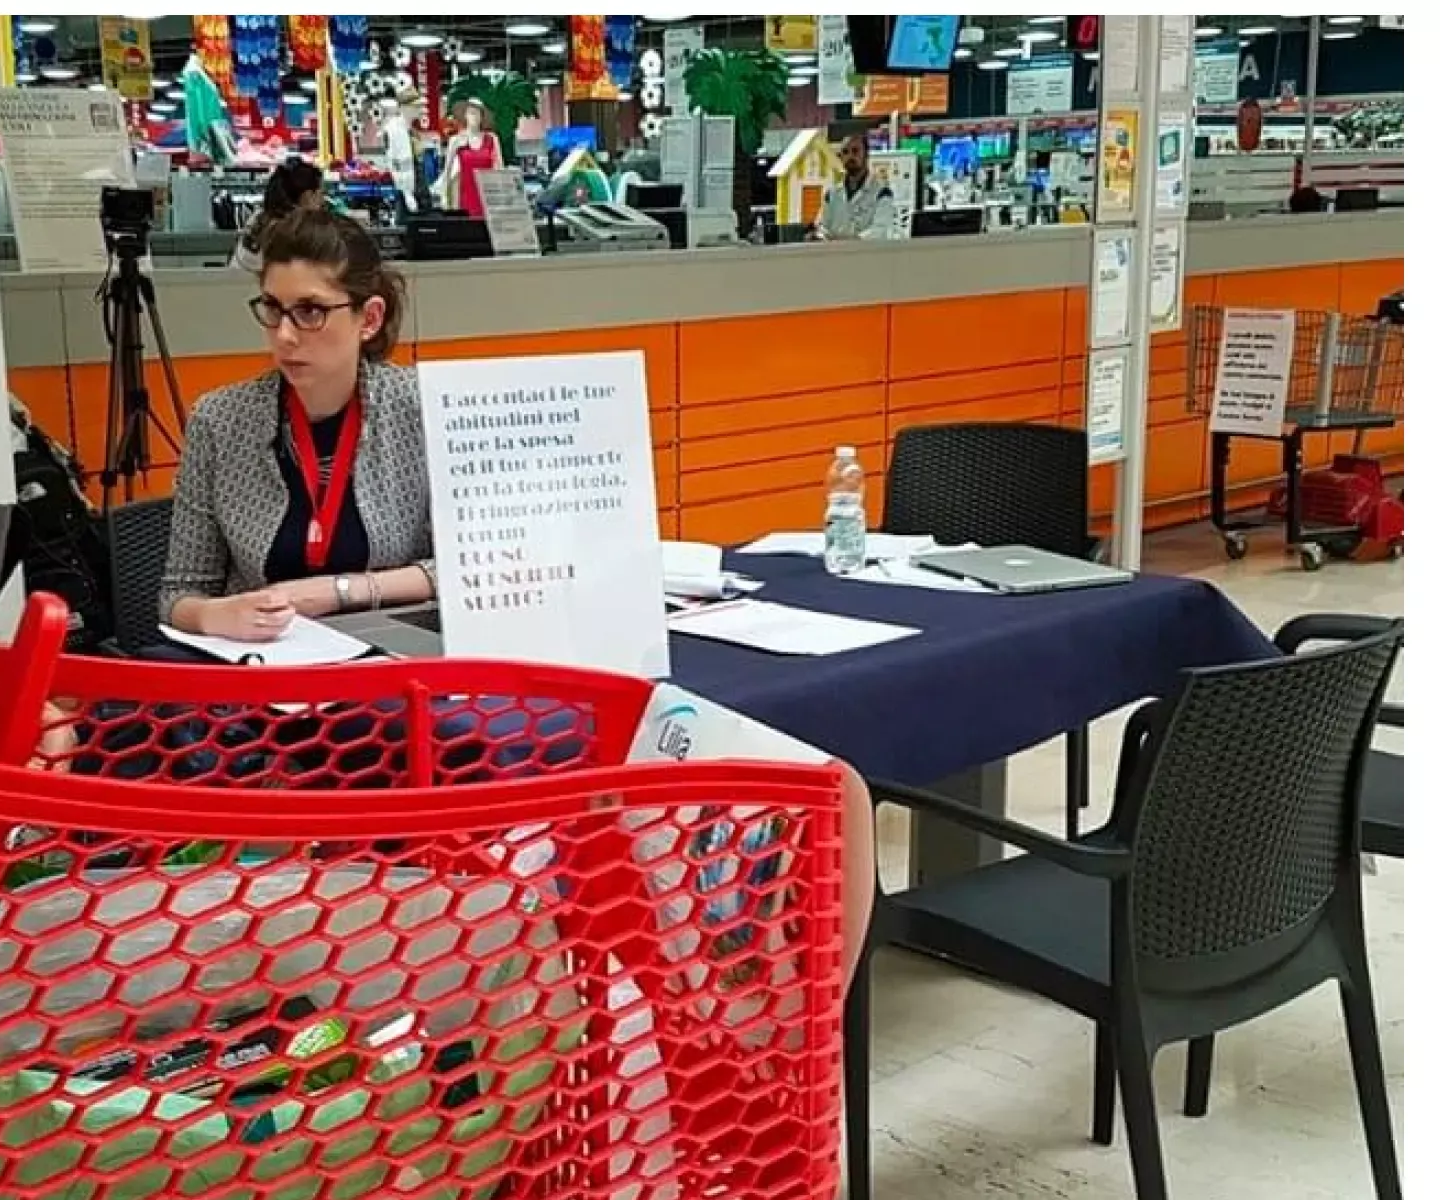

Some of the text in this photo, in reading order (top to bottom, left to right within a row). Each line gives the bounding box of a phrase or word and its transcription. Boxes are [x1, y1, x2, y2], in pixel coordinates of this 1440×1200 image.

[444, 407, 581, 432] abitudini nel
[447, 433, 575, 454] fare la spesa
